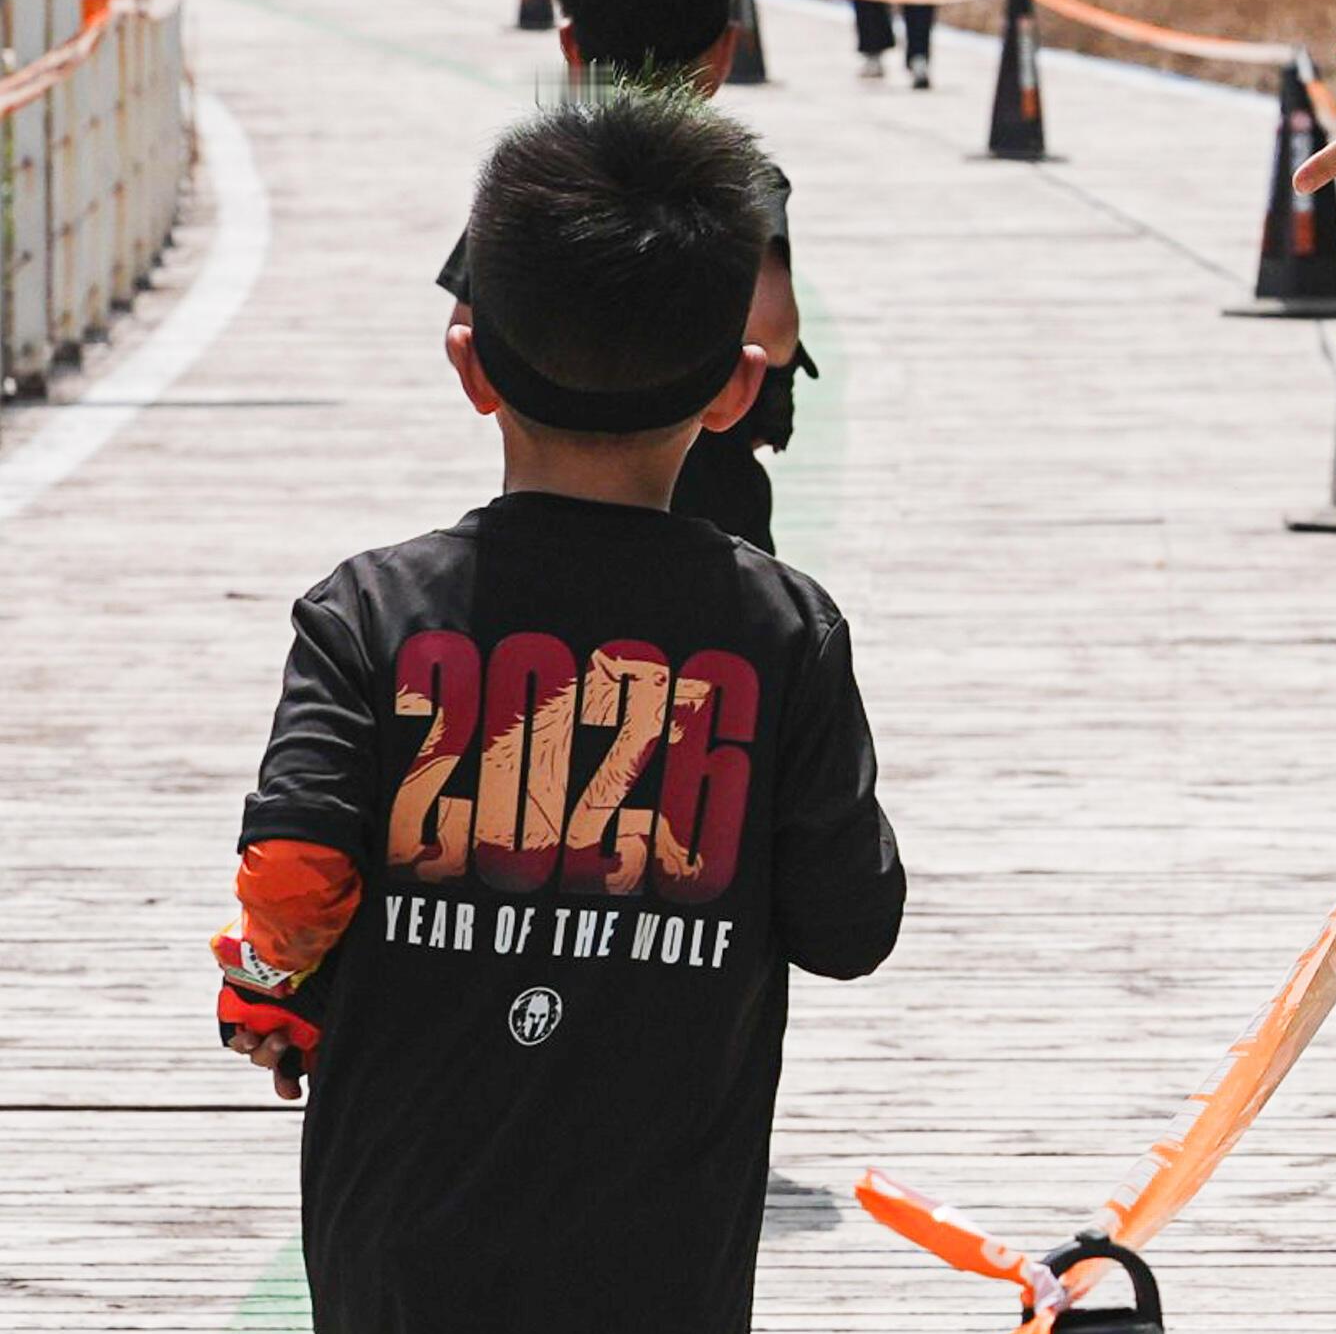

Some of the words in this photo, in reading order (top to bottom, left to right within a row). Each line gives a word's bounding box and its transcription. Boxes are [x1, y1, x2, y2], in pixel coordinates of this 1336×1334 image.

[386, 629, 760, 904] 2026
[385, 894, 476, 951] YEAR
[493, 905, 536, 955] OF
[551, 907, 620, 958] THE
[630, 911, 734, 969] WOLF
